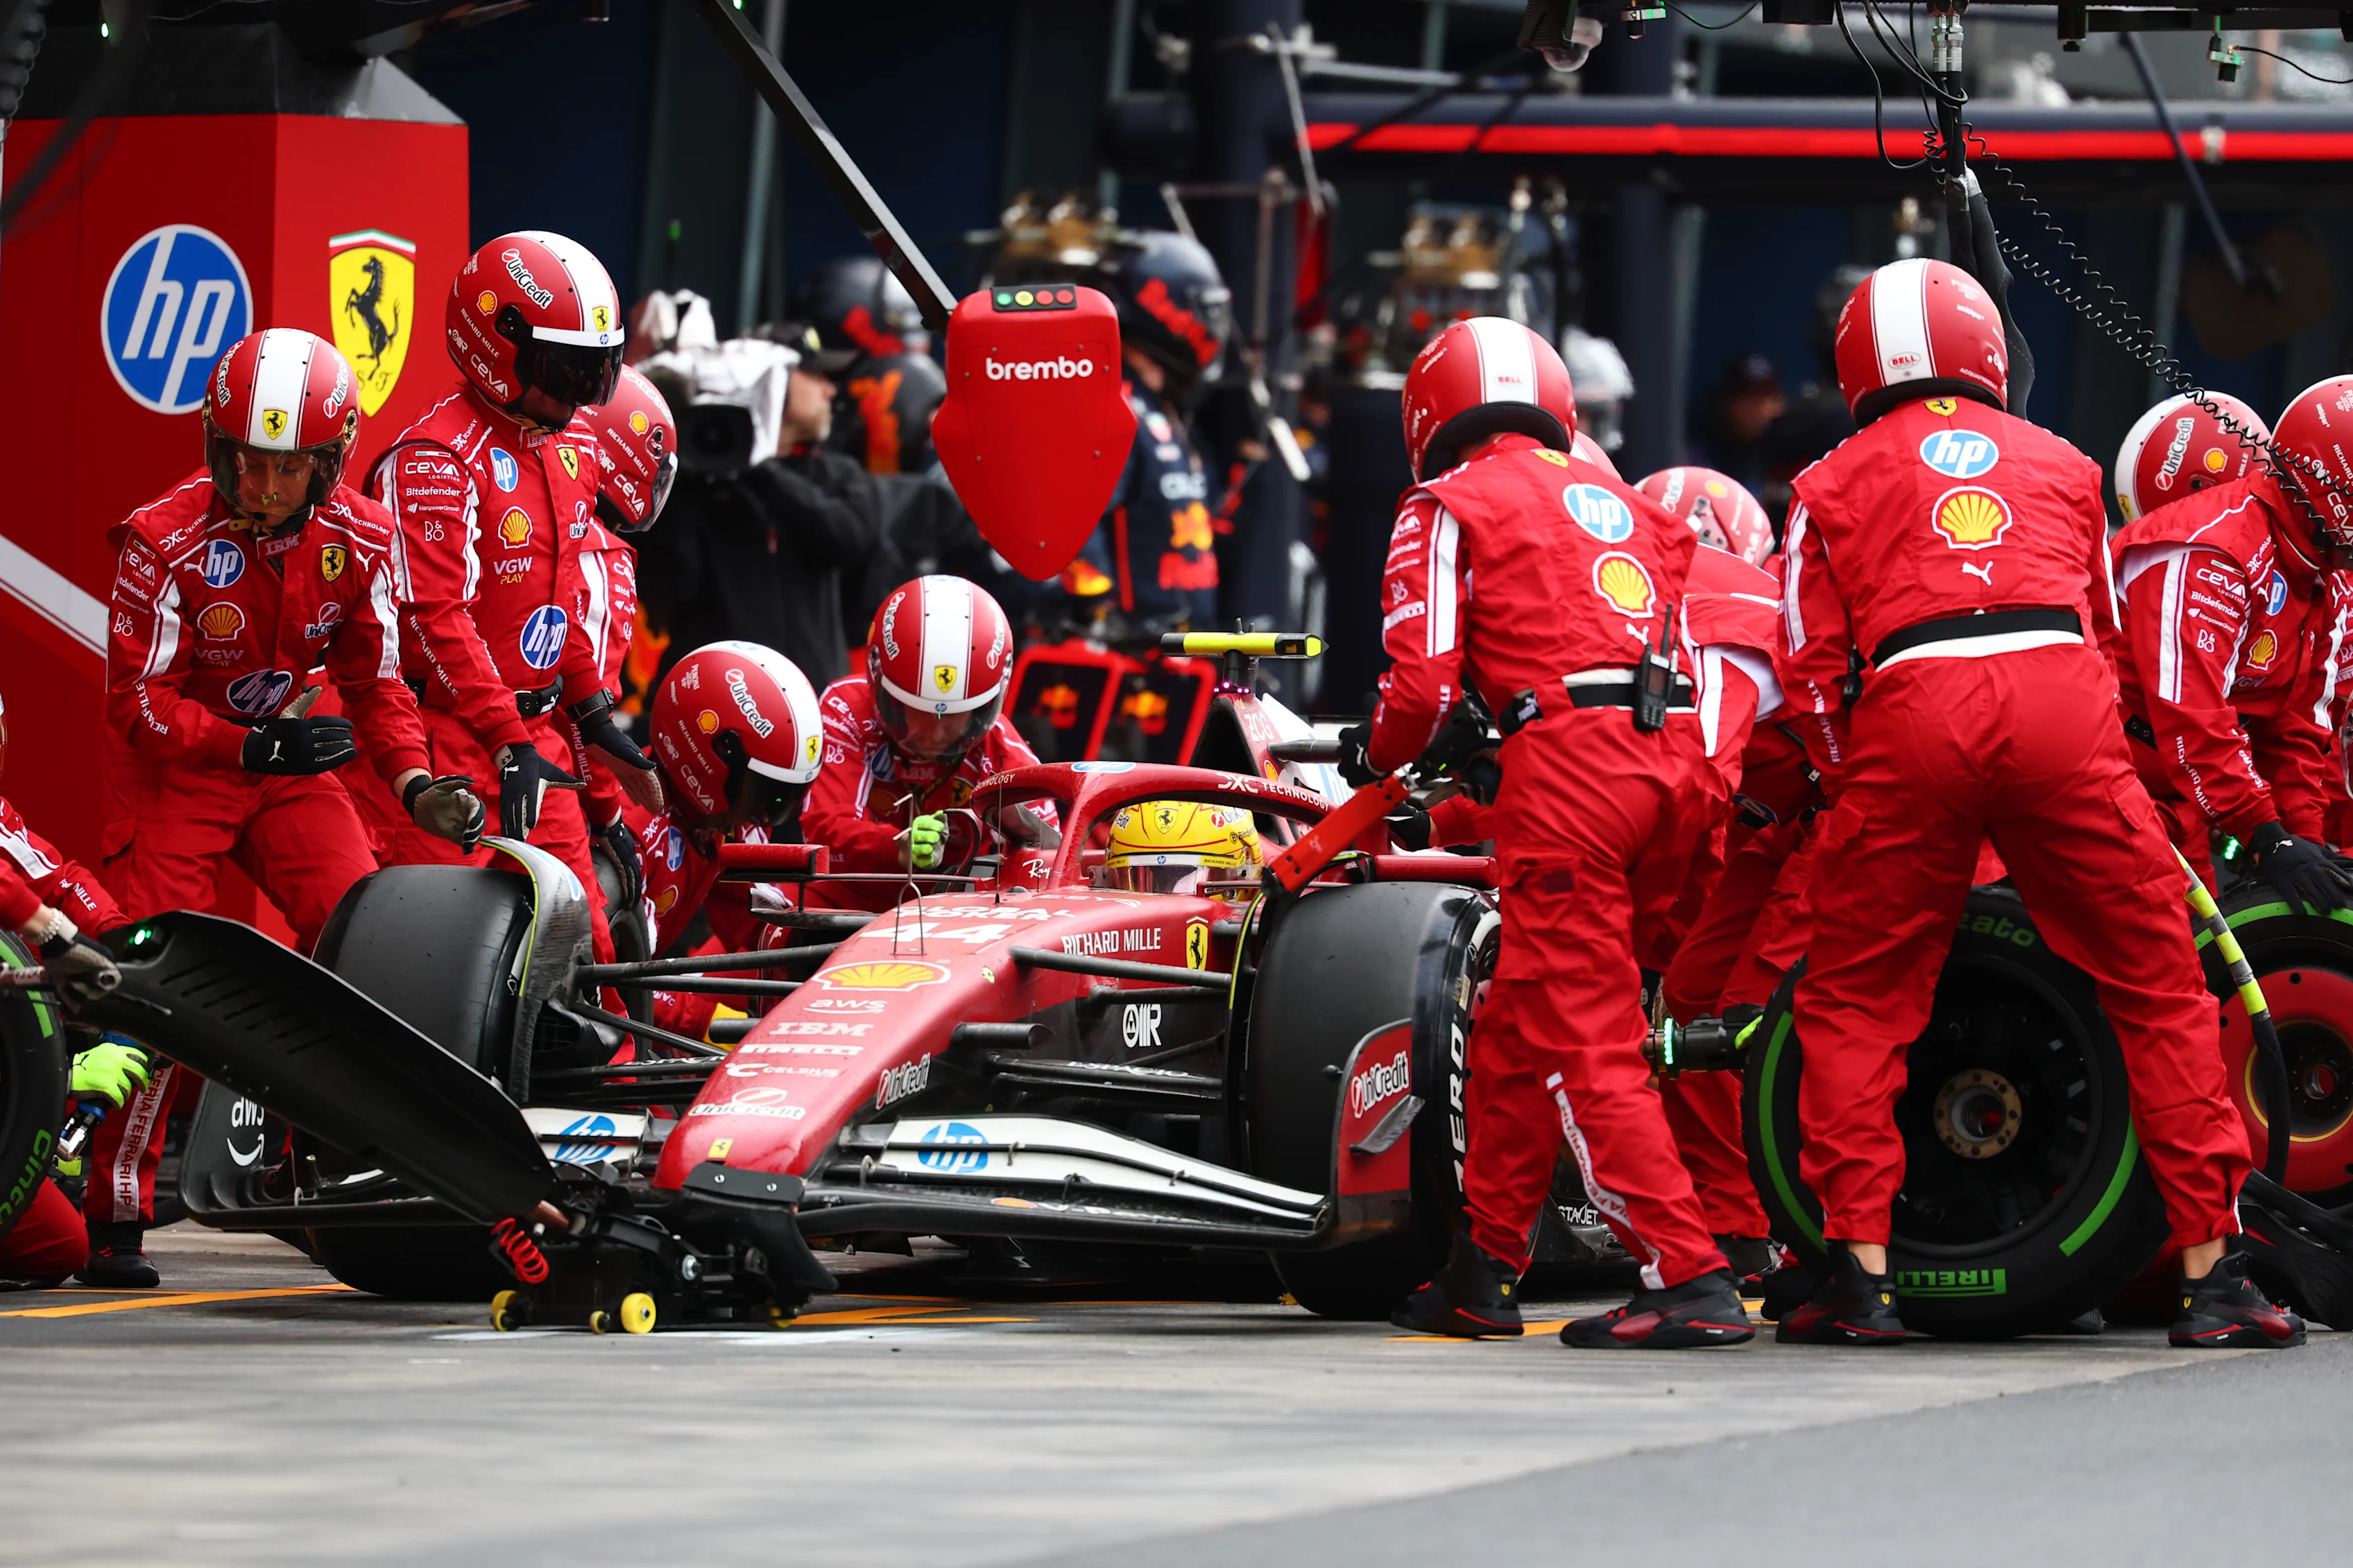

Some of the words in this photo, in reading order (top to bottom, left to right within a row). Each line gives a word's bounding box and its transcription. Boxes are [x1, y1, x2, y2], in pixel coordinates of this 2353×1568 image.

[506, 257, 554, 309] UniCredit
[122, 230, 235, 408] hp
[461, 307, 481, 338] RICHARD
[481, 336, 500, 359] MILLE
[985, 356, 1093, 380] brembo
[1892, 355, 1917, 365] BELL
[217, 350, 234, 408] UniCredit
[481, 379, 506, 402] LOGISTICS
[607, 427, 634, 458] RICHARD
[632, 454, 649, 478] MILLE
[1933, 430, 1986, 479] hp
[2163, 417, 2194, 476] UniCredit
[2332, 443, 2353, 480] RICHARD
[406, 487, 461, 498] Bitdefender
[418, 504, 459, 512] ManpowerGroup
[185, 512, 210, 535] TECHNOL
[1577, 484, 1625, 544] hp
[265, 533, 300, 555] IBM
[206, 540, 237, 587] hp
[493, 557, 533, 575] VGW
[500, 574, 524, 585] PLAY
[2191, 591, 2241, 619] Bitdefender
[2218, 587, 2245, 605] LOGISTICS
[525, 608, 565, 668] hp
[882, 603, 899, 661] UniCredit
[194, 648, 243, 661] VGW
[410, 614, 436, 663] RICHARD
[436, 664, 458, 698] MILLE
[238, 670, 284, 717] hp
[730, 682, 774, 739] UniCredit
[678, 720, 698, 753] RICHARD
[696, 751, 715, 775] MILLE
[1216, 773, 1259, 793] DXC
[1261, 782, 1330, 812] TECHNOLOGY
[2176, 736, 2201, 785] RICHARD
[2194, 785, 2220, 818] MILLE
[73, 882, 97, 911] MILLE
[858, 922, 1013, 944] 44
[1061, 930, 1120, 956] RICHARD
[1122, 927, 1161, 951] MILLE
[810, 999, 887, 1010] aws
[769, 1022, 874, 1037] IBM
[738, 1044, 864, 1056] PIRELLI
[886, 1052, 931, 1104] UniCredit
[1361, 1050, 1409, 1111] UniCredit
[231, 1096, 264, 1128] aws
[690, 1103, 805, 1119] UniCredit
[119, 1113, 151, 1180] FERRARI
[927, 1122, 984, 1173] hp
[119, 1182, 134, 1207] HP
[1897, 1268, 2007, 1298] PIRELLI
